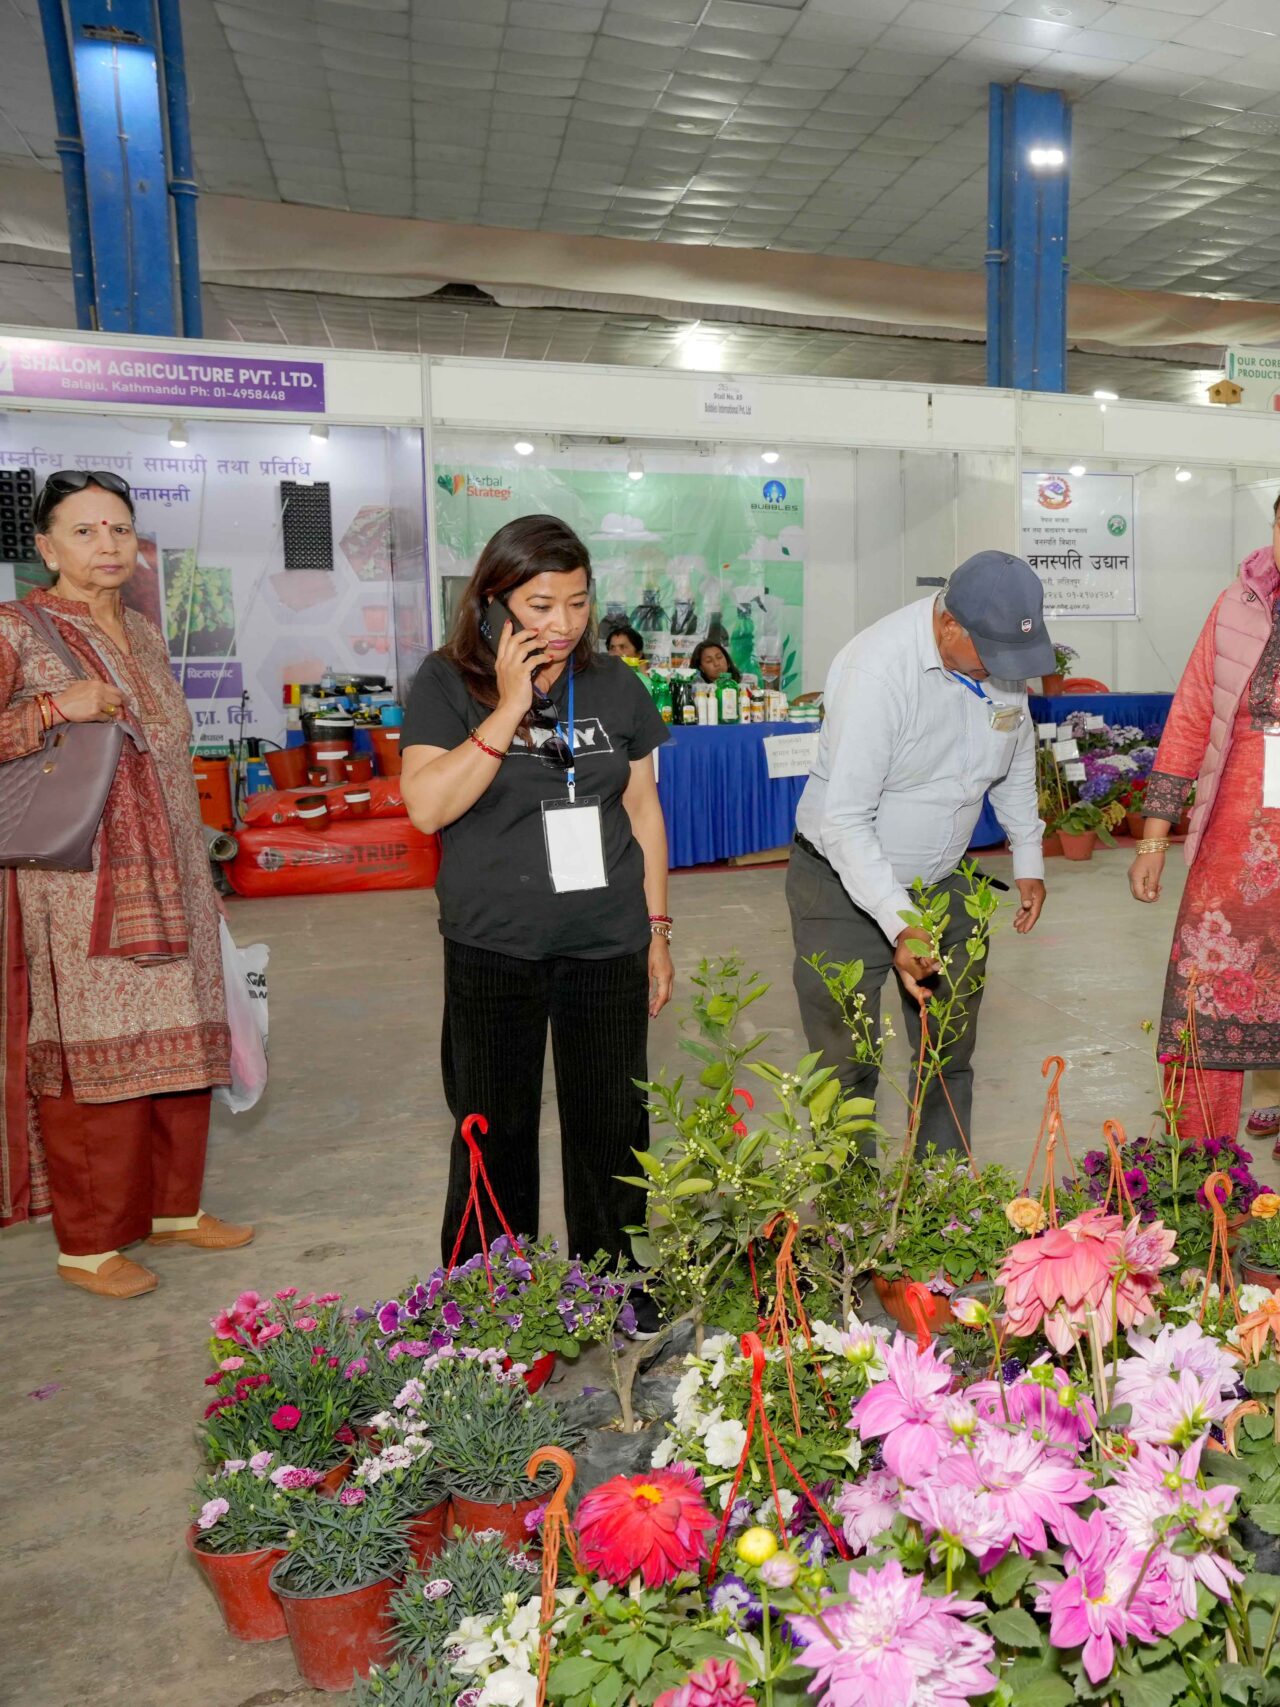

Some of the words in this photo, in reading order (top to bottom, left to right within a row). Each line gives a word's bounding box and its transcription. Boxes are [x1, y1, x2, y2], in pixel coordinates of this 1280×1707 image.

[21, 354, 102, 375] SHALOM
[107, 361, 234, 383] AGRICULTURE
[239, 368, 276, 385] PVT.
[280, 371, 318, 388] LTD.
[1237, 356, 1257, 366] OUR
[61, 377, 108, 392] Balaju,
[111, 380, 186, 396] Kathmandu
[190, 385, 210, 397] Ph:
[213, 387, 286, 401] 01-4958448
[217, 459, 249, 475] तथा
[260, 455, 312, 477] प्रविधि
[466, 473, 503, 487] Herbal
[750, 503, 799, 512] BUBBLES
[1026, 548, 1083, 570] वनस्पति
[1089, 555, 1130, 571] उद्यान
[227, 704, 258, 725] लि.
